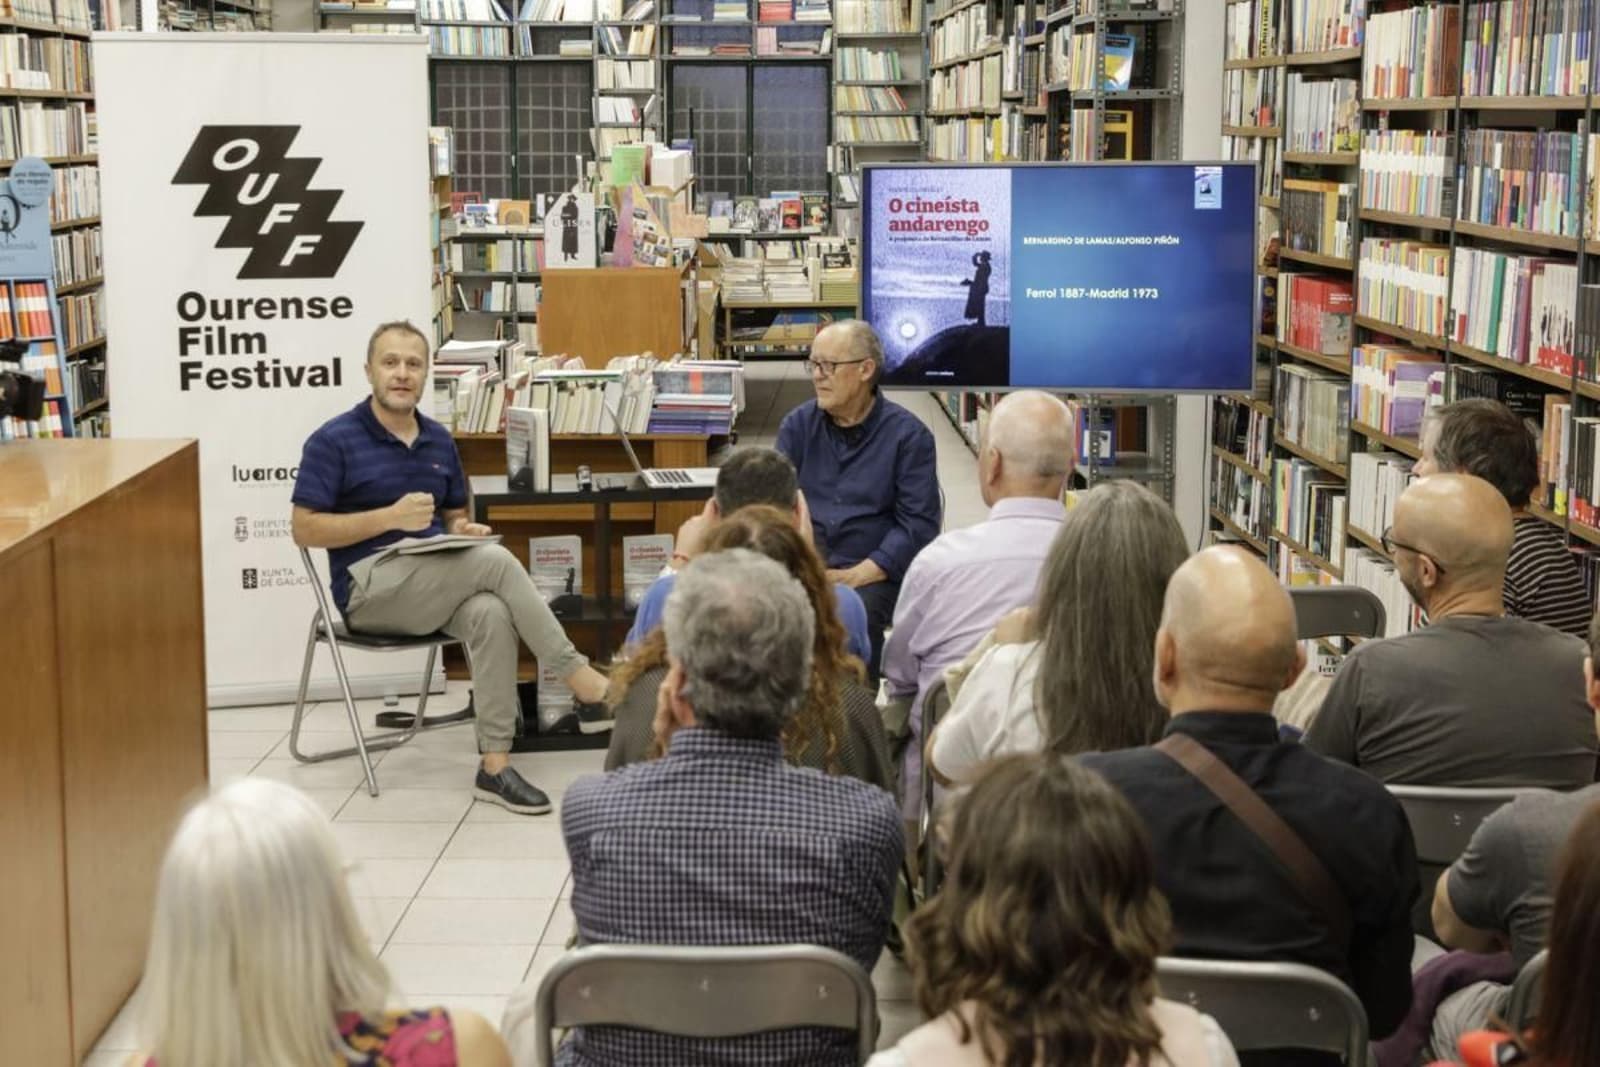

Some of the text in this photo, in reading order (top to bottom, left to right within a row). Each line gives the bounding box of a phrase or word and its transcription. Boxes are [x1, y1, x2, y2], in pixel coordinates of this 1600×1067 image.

[889, 195, 980, 214] O cineísta
[888, 215, 990, 237] andarengo
[1023, 236, 1073, 245] BERNARDINO
[1075, 236, 1084, 245] DE
[1154, 234, 1180, 245] PIÑÓN
[1026, 287, 1159, 299] Ferrol 1887-Madrid 1973
[177, 291, 353, 322] Ourense
[178, 326, 267, 356] Film
[180, 357, 342, 391] Festival
[253, 529, 291, 539] OUREN
[261, 567, 295, 577] XUNTA
[260, 577, 272, 588] DE
